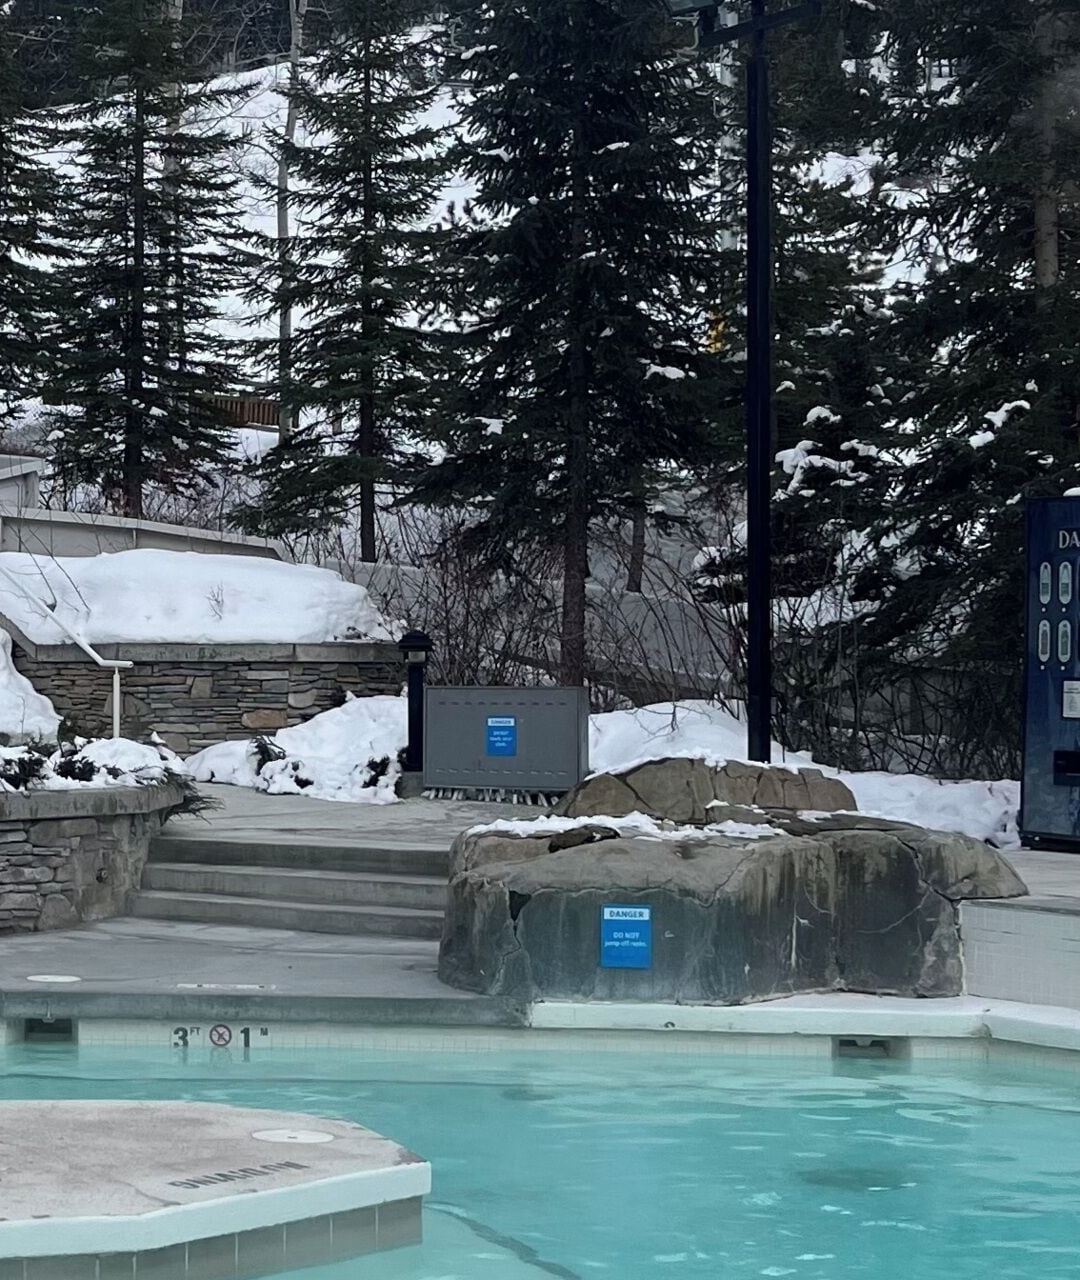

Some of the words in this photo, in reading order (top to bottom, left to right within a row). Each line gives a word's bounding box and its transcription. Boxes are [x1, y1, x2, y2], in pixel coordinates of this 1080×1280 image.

[1059, 530, 1080, 549] DA
[609, 910, 644, 918] DANGER
[612, 931, 624, 939] DO
[624, 932, 640, 940] NOT
[173, 1026, 189, 1048] 3
[190, 1026, 201, 1035] FT
[240, 1027, 250, 1048] 1
[260, 1027, 268, 1036] M
